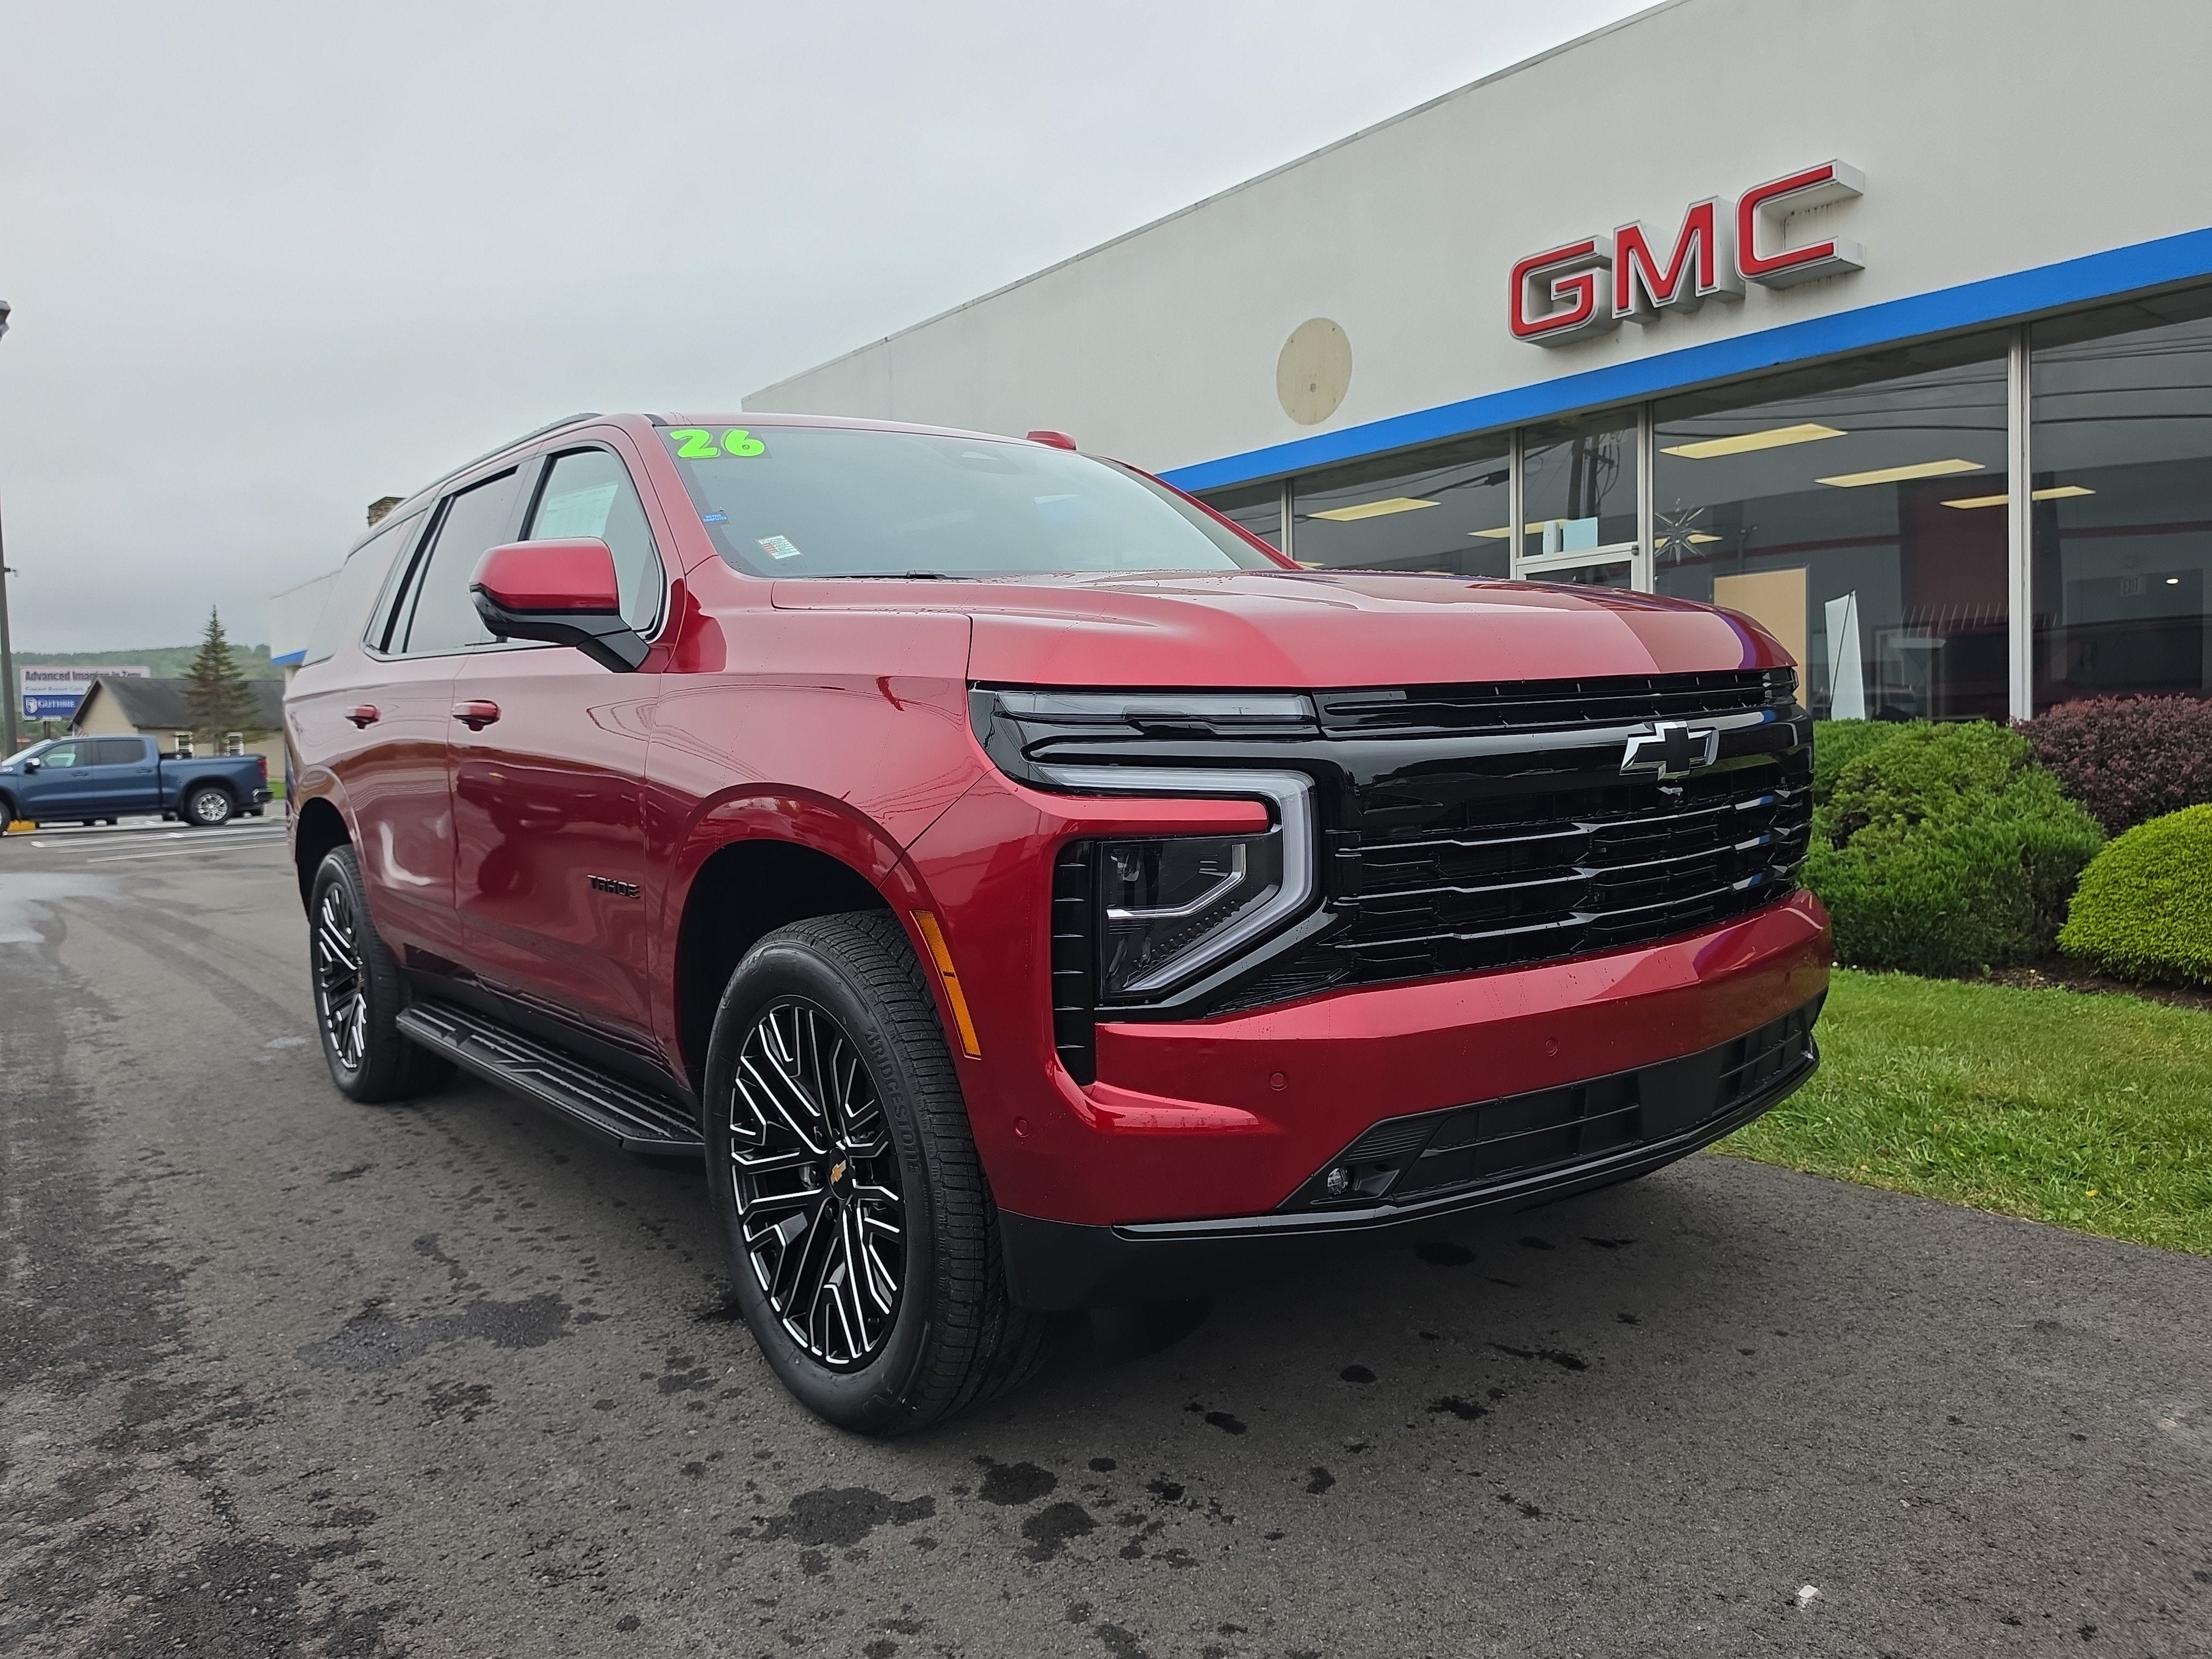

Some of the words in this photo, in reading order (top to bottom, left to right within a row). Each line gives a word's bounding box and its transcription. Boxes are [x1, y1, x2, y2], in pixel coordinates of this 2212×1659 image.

[1509, 158, 1863, 343] GMC
[669, 428, 766, 459] 26
[25, 671, 70, 681] Advanced
[587, 874, 640, 899] TAHOE
[865, 1027, 921, 1173] BRIDGESTONE
